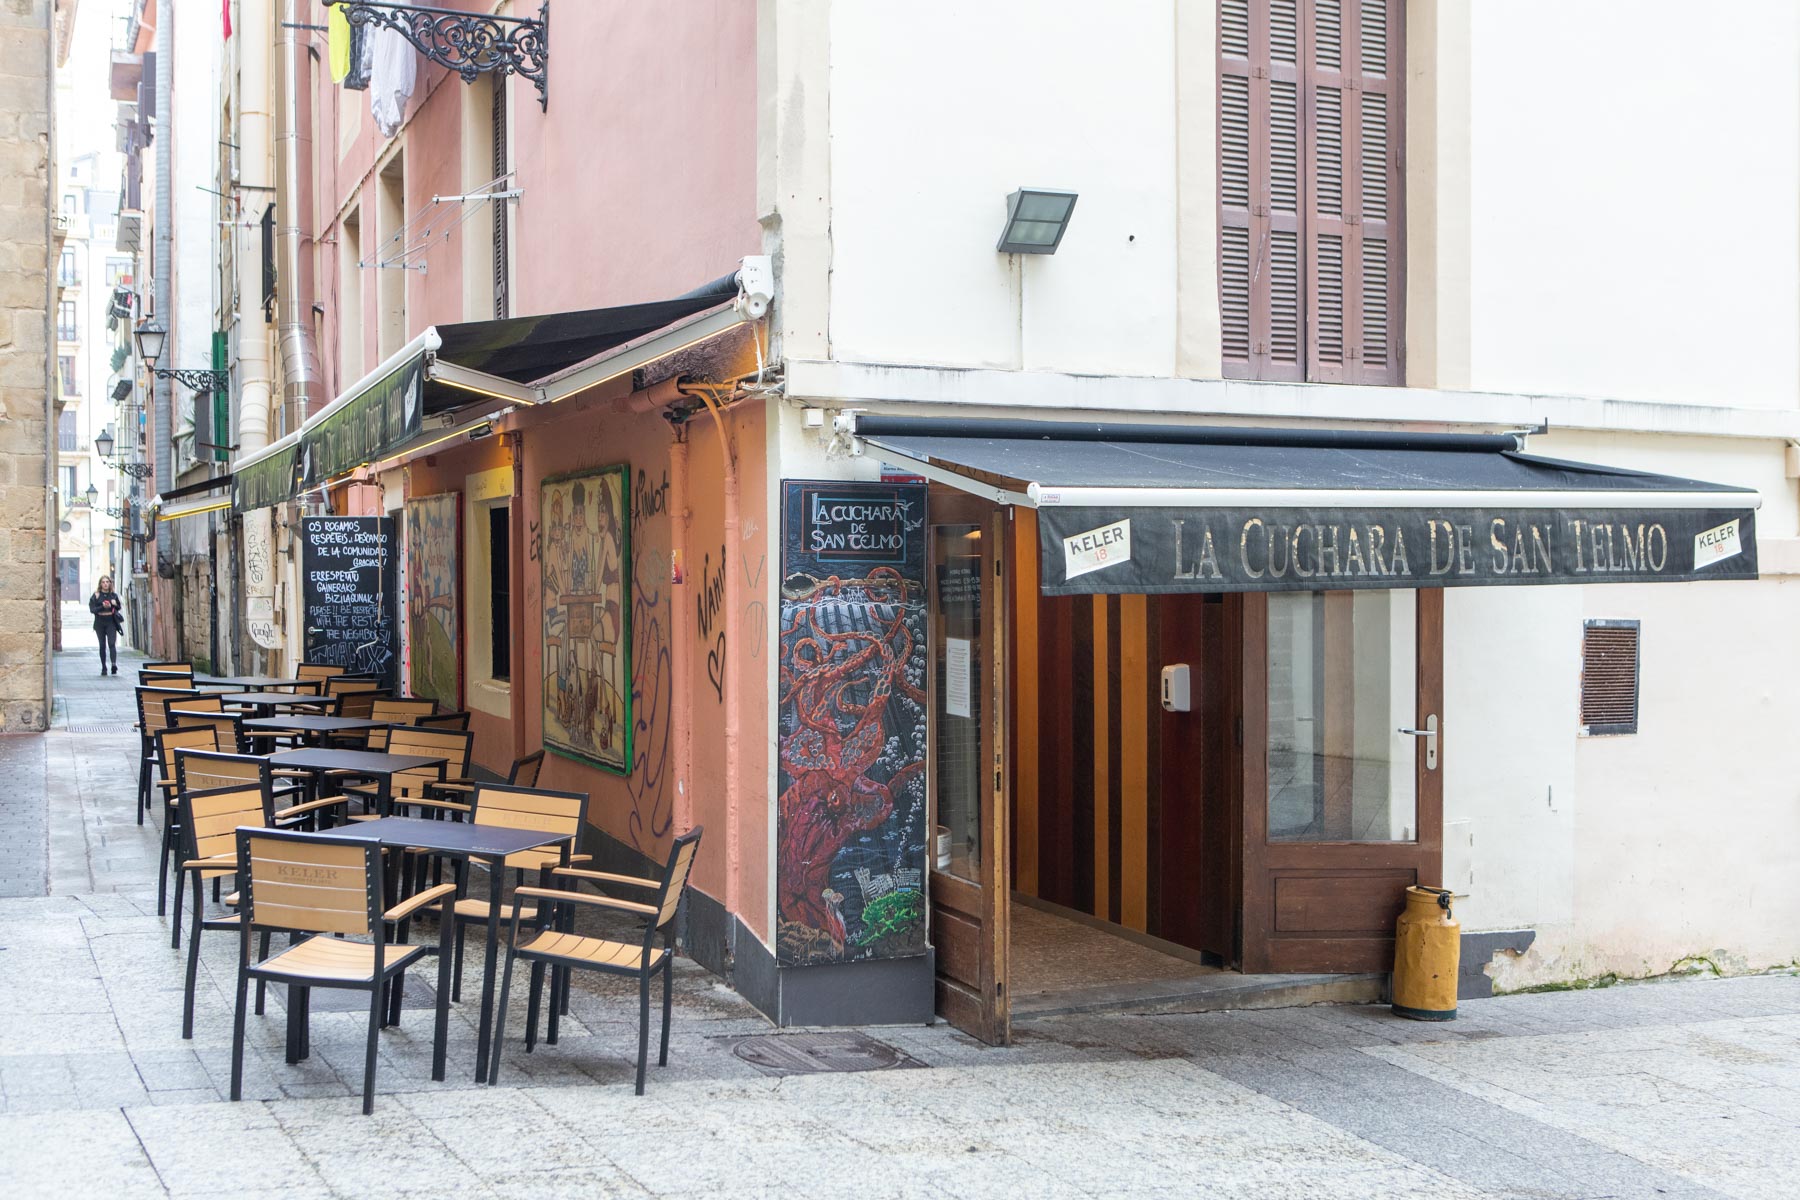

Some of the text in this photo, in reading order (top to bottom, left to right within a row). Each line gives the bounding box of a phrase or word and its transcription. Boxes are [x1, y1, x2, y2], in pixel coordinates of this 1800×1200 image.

[812, 493, 904, 524] LA CUCHARA
[308, 521, 360, 532] OS ROGAMOS
[851, 523, 868, 534] DE
[810, 530, 904, 551] SAN TELMO
[1070, 527, 1124, 555] KELER
[1698, 525, 1735, 549] KELER
[317, 546, 330, 556] DE
[331, 546, 341, 558] LA
[1093, 548, 1108, 561] 18
[1171, 518, 1668, 579] LA CUCHARA DE SAN TELMO
[1714, 543, 1724, 555] 18
[310, 571, 360, 582] ERRESPETATU
[316, 582, 357, 593] GAINERAKO
[340, 605, 352, 614] BE
[351, 615, 373, 628] REST
[277, 865, 338, 880] KELER
